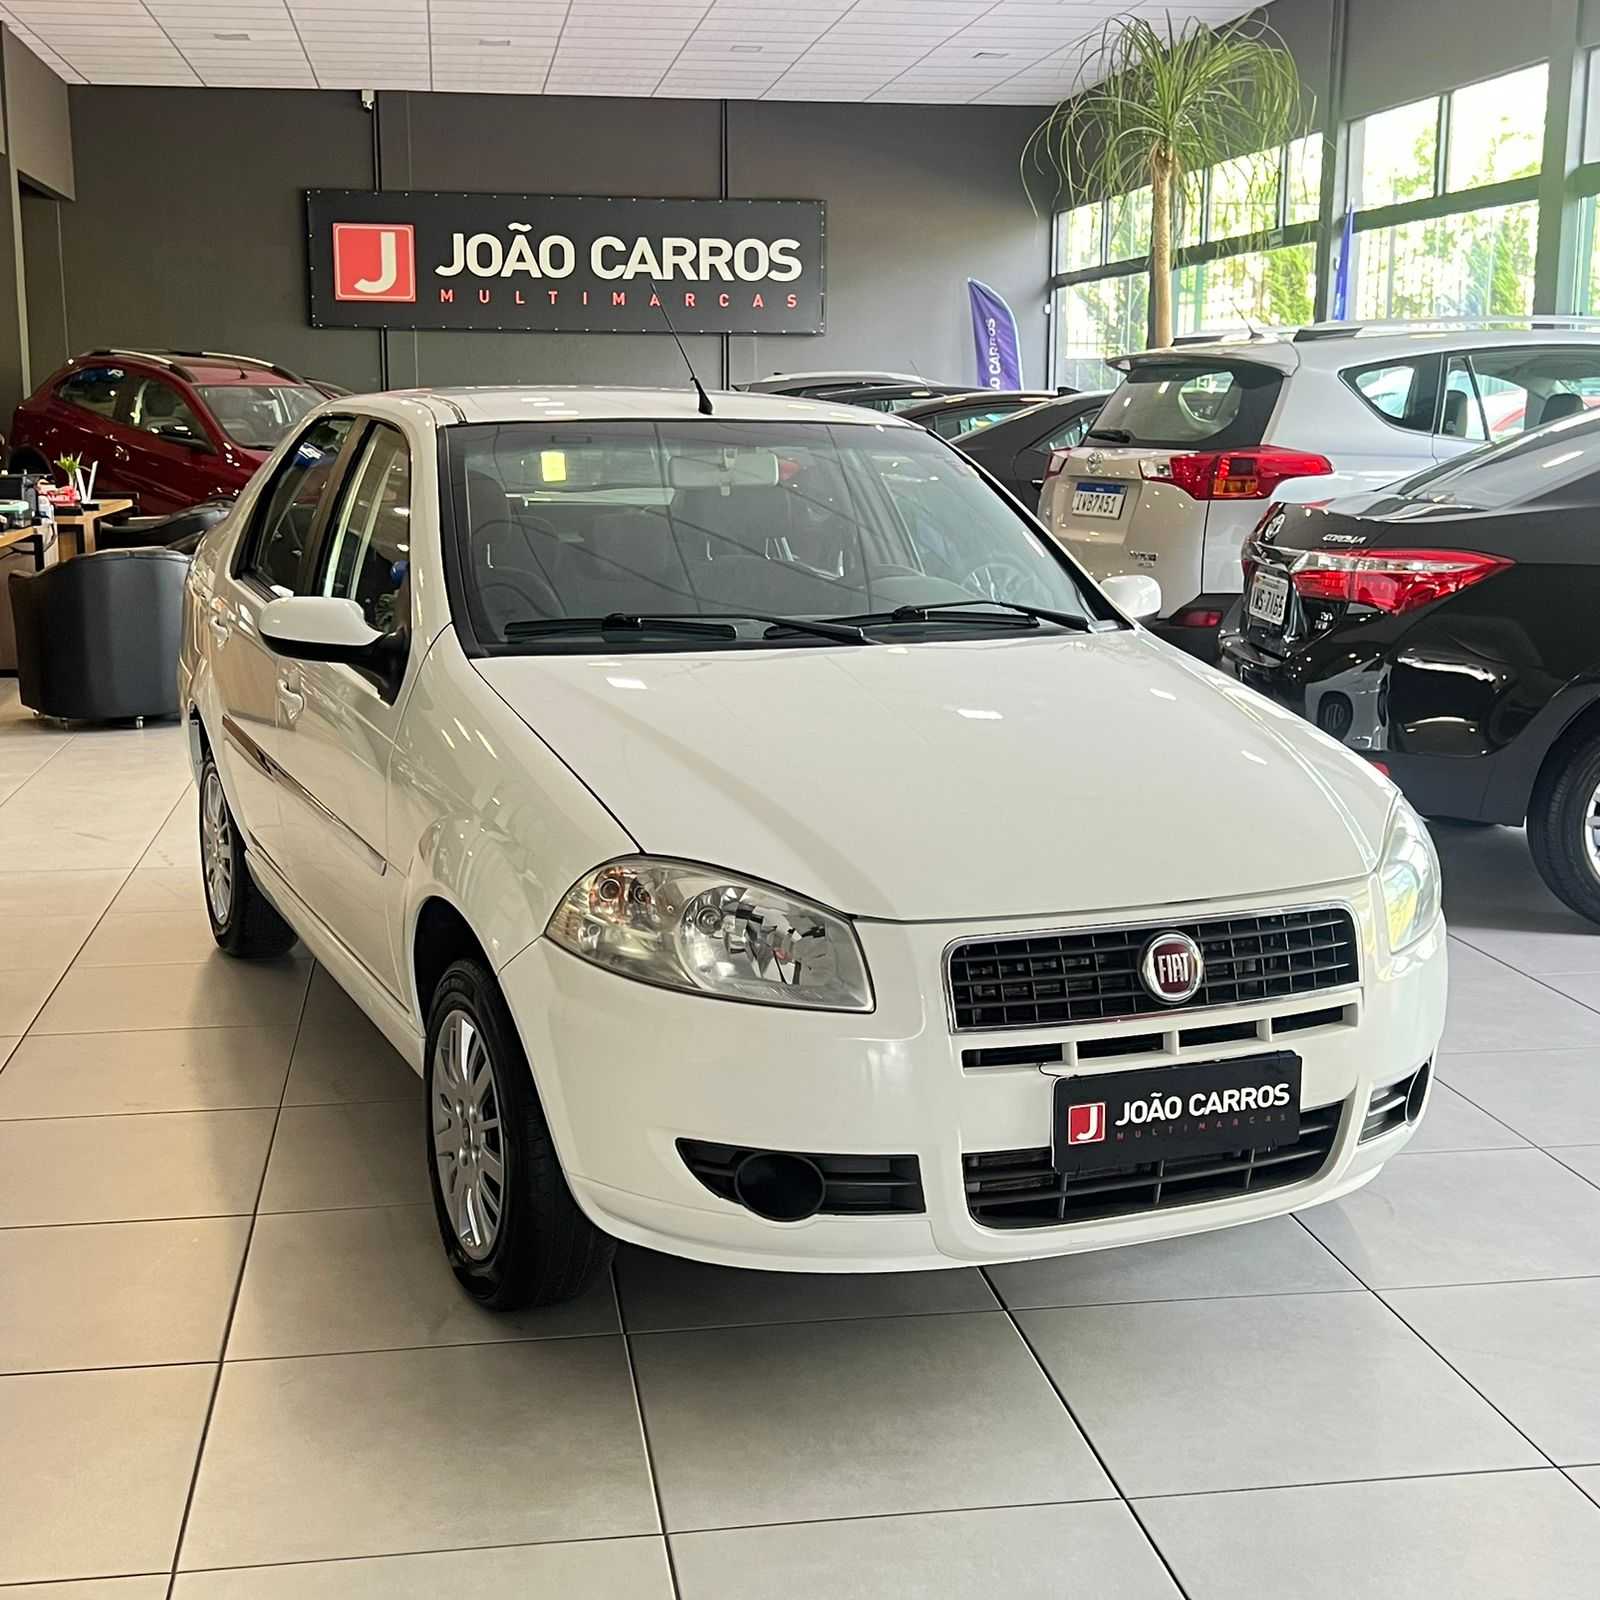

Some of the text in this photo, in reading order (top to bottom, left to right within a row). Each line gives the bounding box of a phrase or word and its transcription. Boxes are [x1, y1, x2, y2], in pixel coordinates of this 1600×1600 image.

[354, 231, 396, 294] J
[434, 222, 803, 282] JOÃO CARROS
[441, 288, 798, 308] MULTIMARCAS
[1157, 952, 1189, 984] FIAT
[1076, 1105, 1099, 1140] J
[1114, 1083, 1290, 1126] JOÃO CARROS
